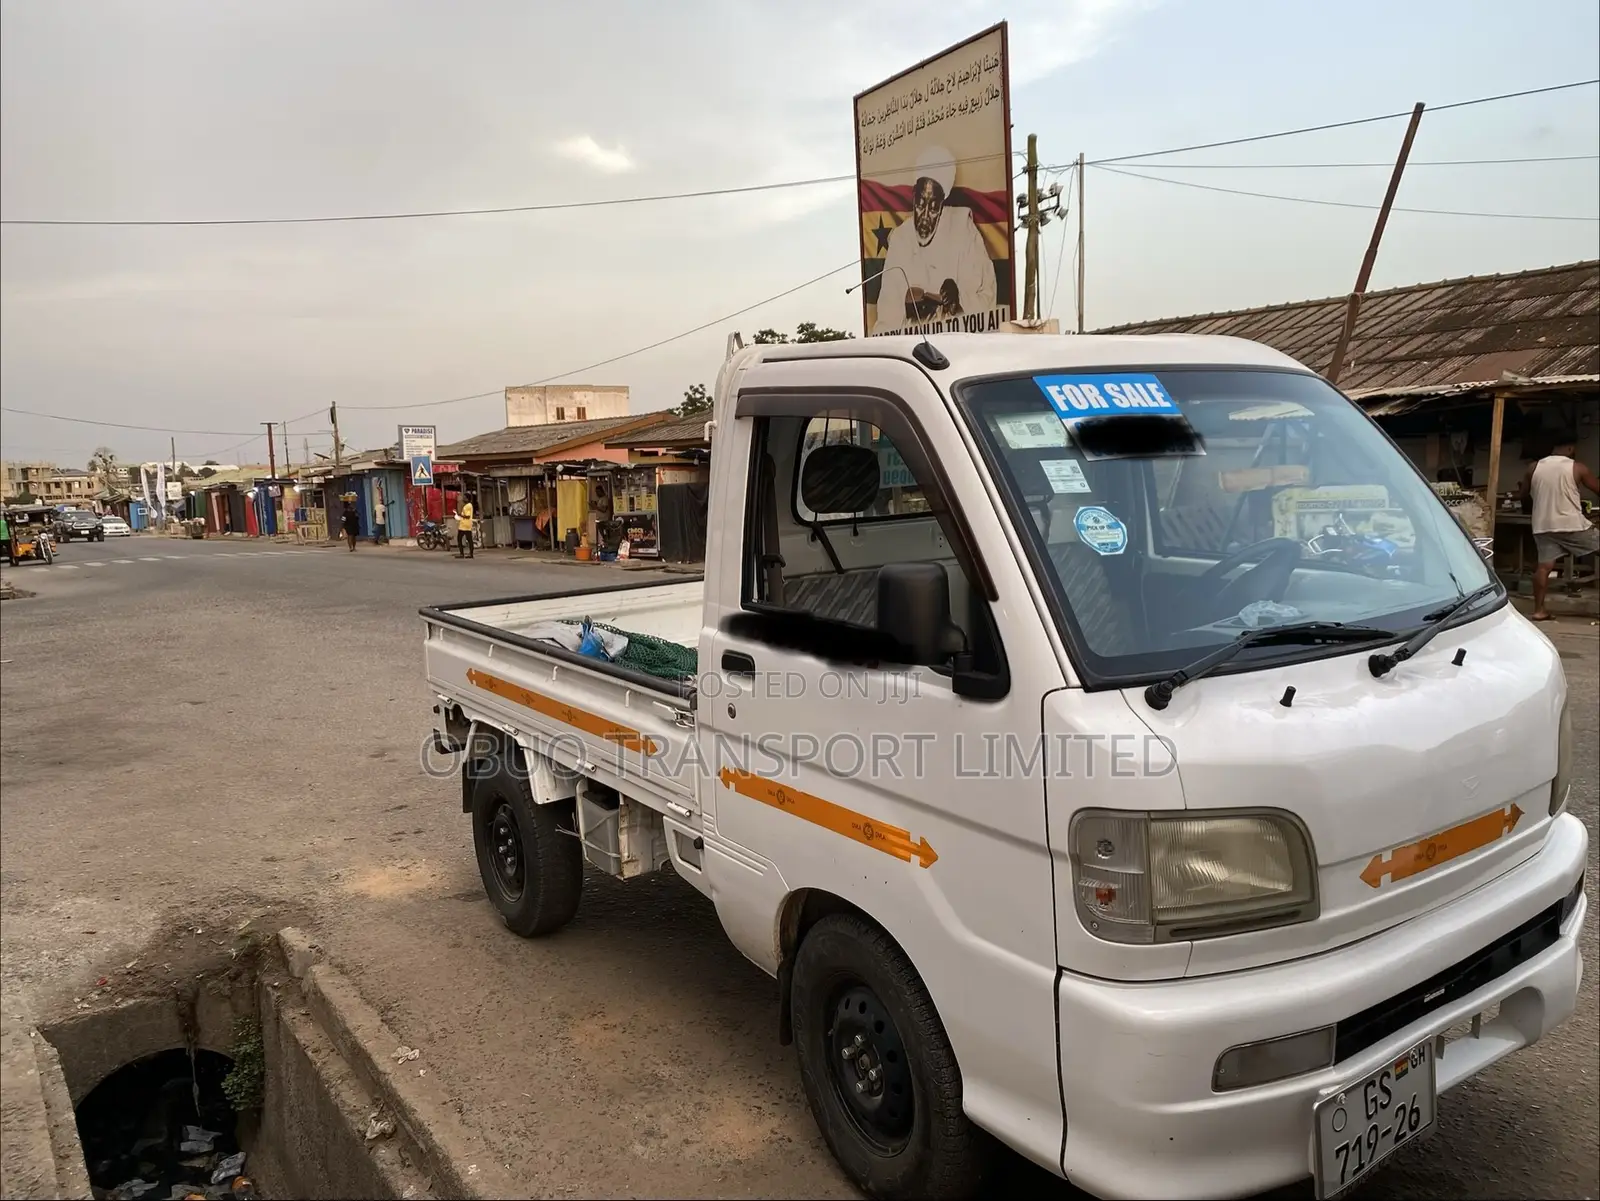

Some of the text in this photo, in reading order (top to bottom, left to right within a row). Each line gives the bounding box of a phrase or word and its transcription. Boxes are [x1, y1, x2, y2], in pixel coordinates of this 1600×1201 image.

[963, 312, 984, 333] YOU
[1046, 383, 1172, 412] FOR SALE
[1410, 1046, 1425, 1069] GH
[1363, 1071, 1392, 1121] GS
[1334, 1093, 1421, 1185] 719-26
